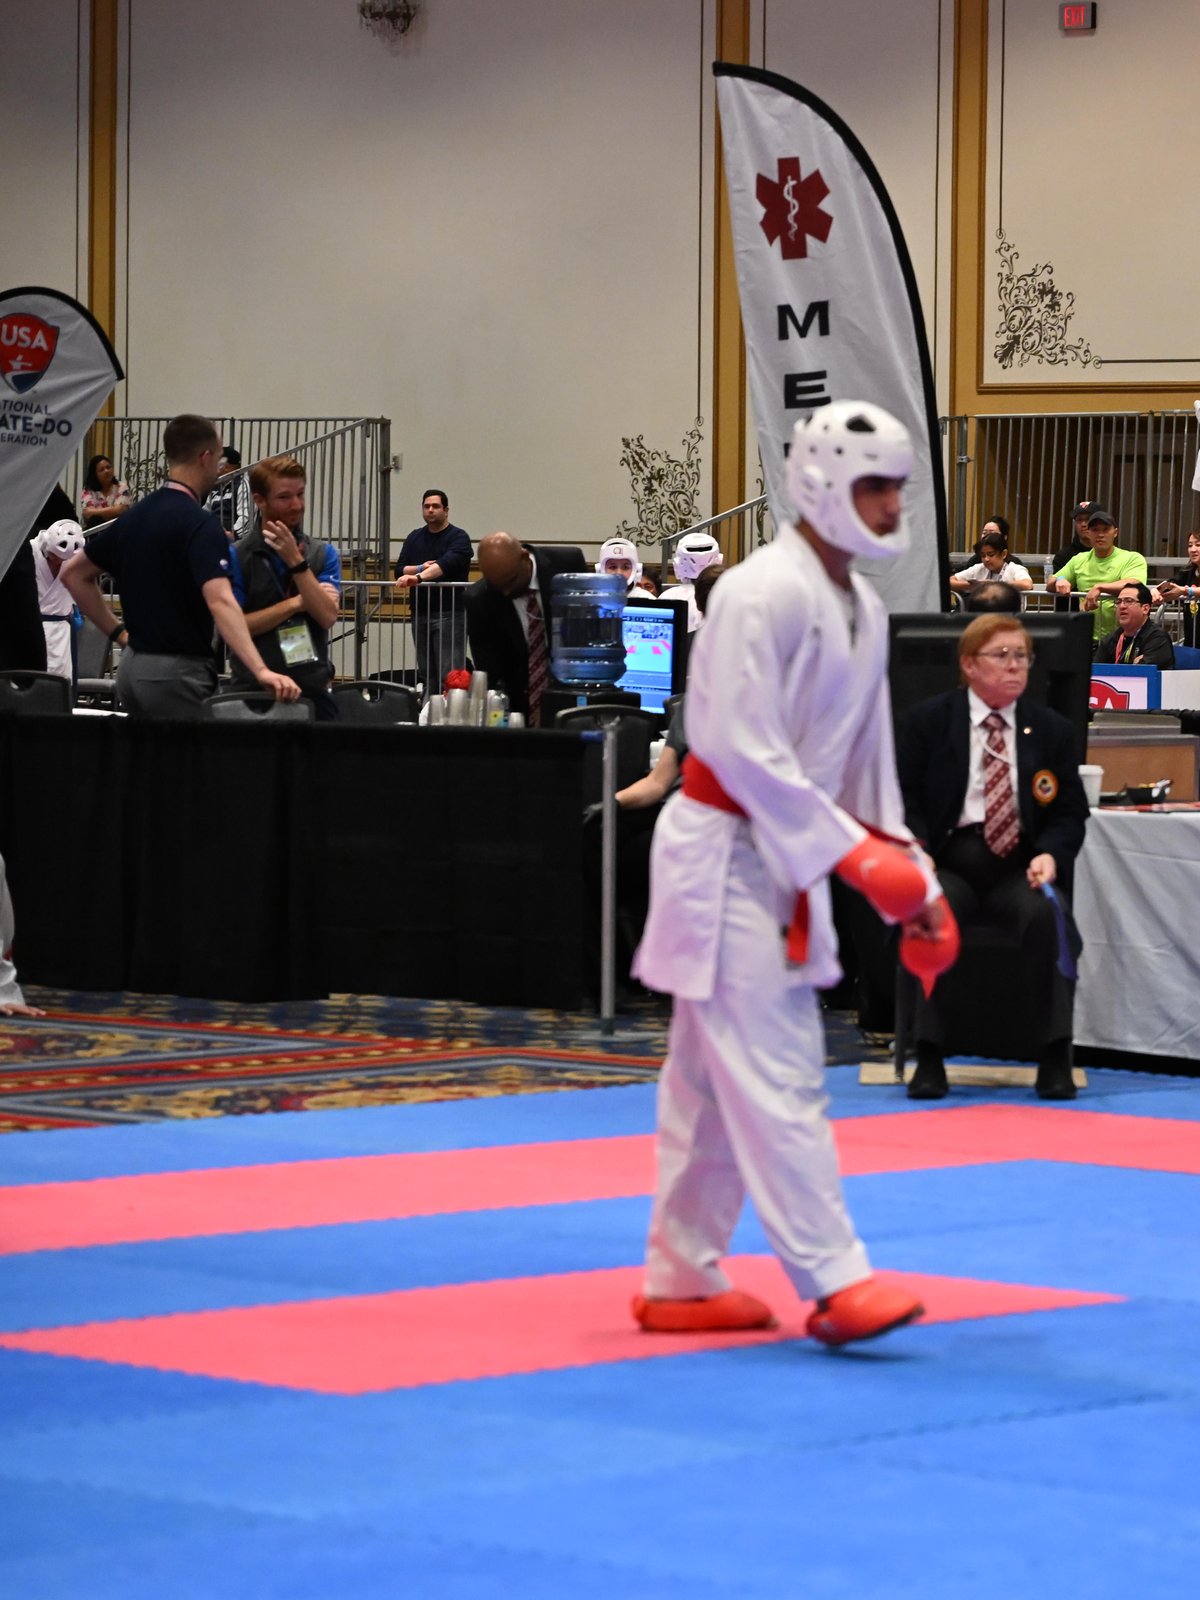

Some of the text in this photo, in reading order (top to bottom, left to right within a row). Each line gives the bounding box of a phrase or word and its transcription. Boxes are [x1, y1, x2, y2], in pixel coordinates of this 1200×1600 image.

[1064, 5, 1085, 26] EXIT
[1, 323, 48, 351] USA
[776, 300, 832, 457] ME
[0, 399, 52, 415] TIONAL
